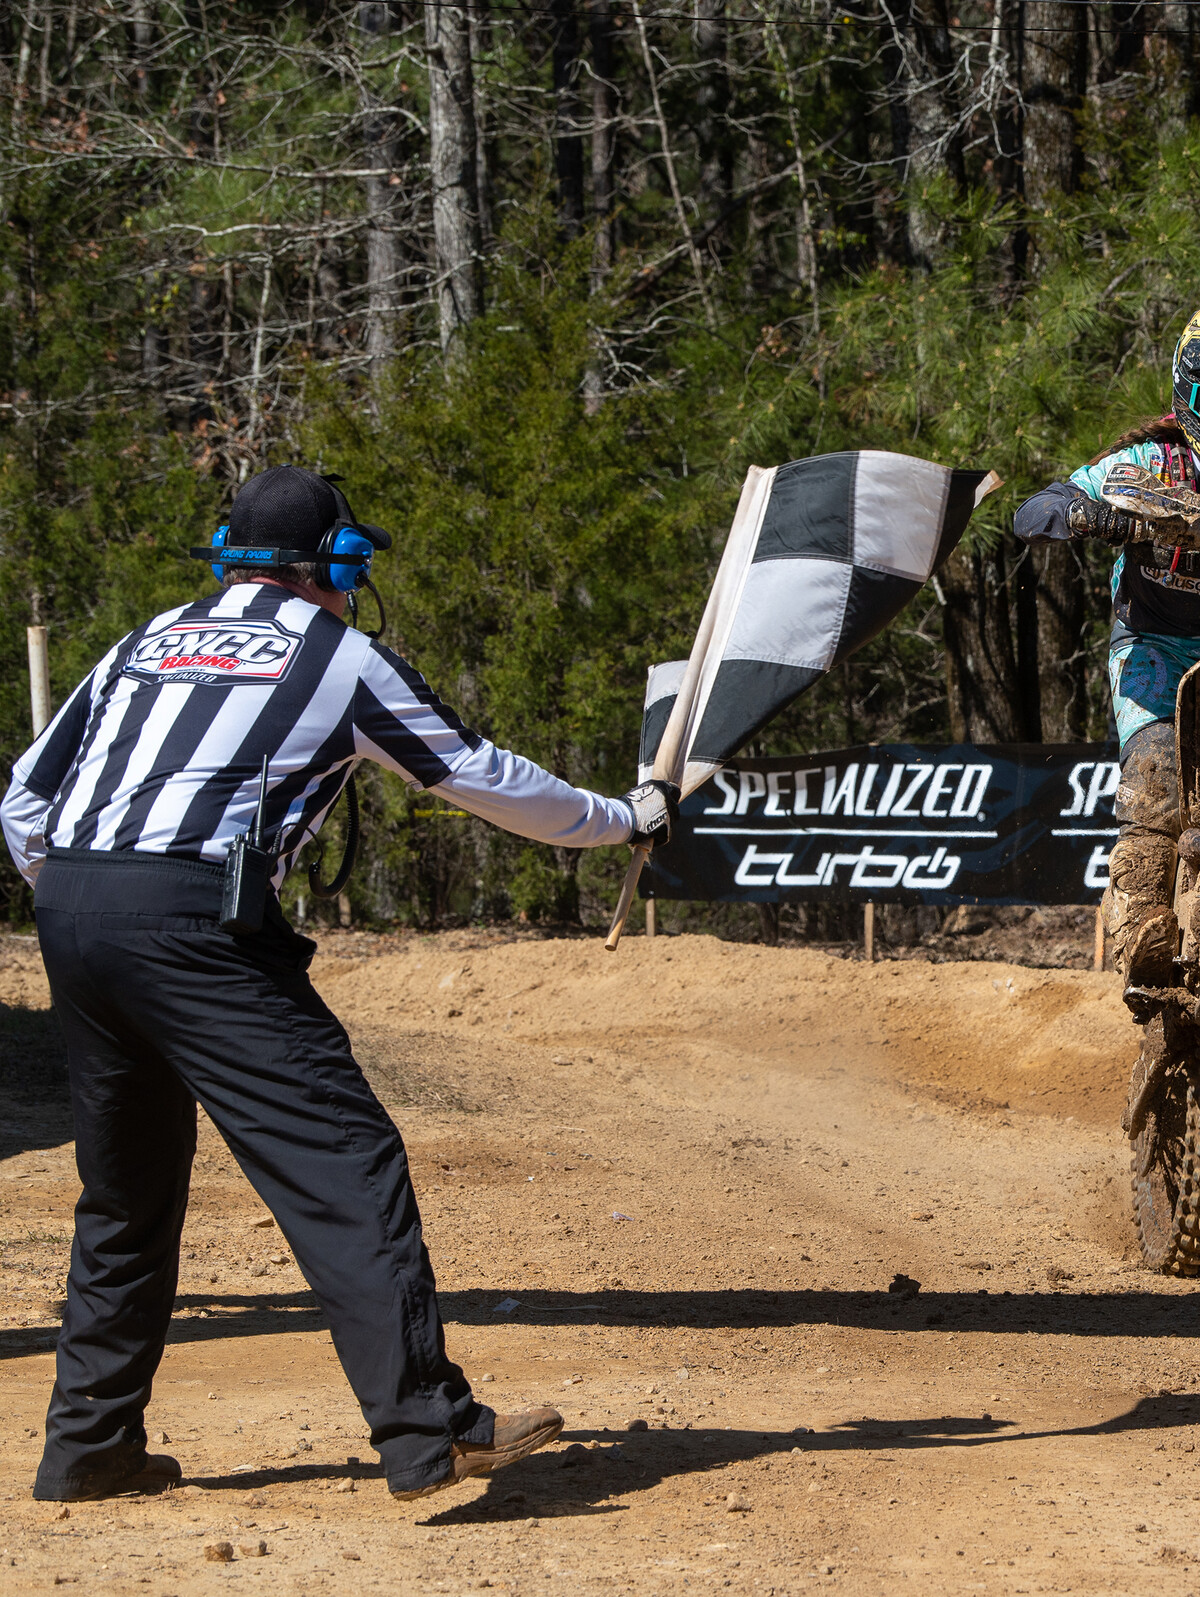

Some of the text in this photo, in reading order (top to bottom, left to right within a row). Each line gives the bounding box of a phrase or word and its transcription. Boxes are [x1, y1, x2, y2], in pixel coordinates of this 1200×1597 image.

[220, 549, 245, 558] RACING
[158, 655, 241, 671] RACING
[703, 762, 993, 817] SPECIALIZED
[734, 844, 962, 889] turbo
